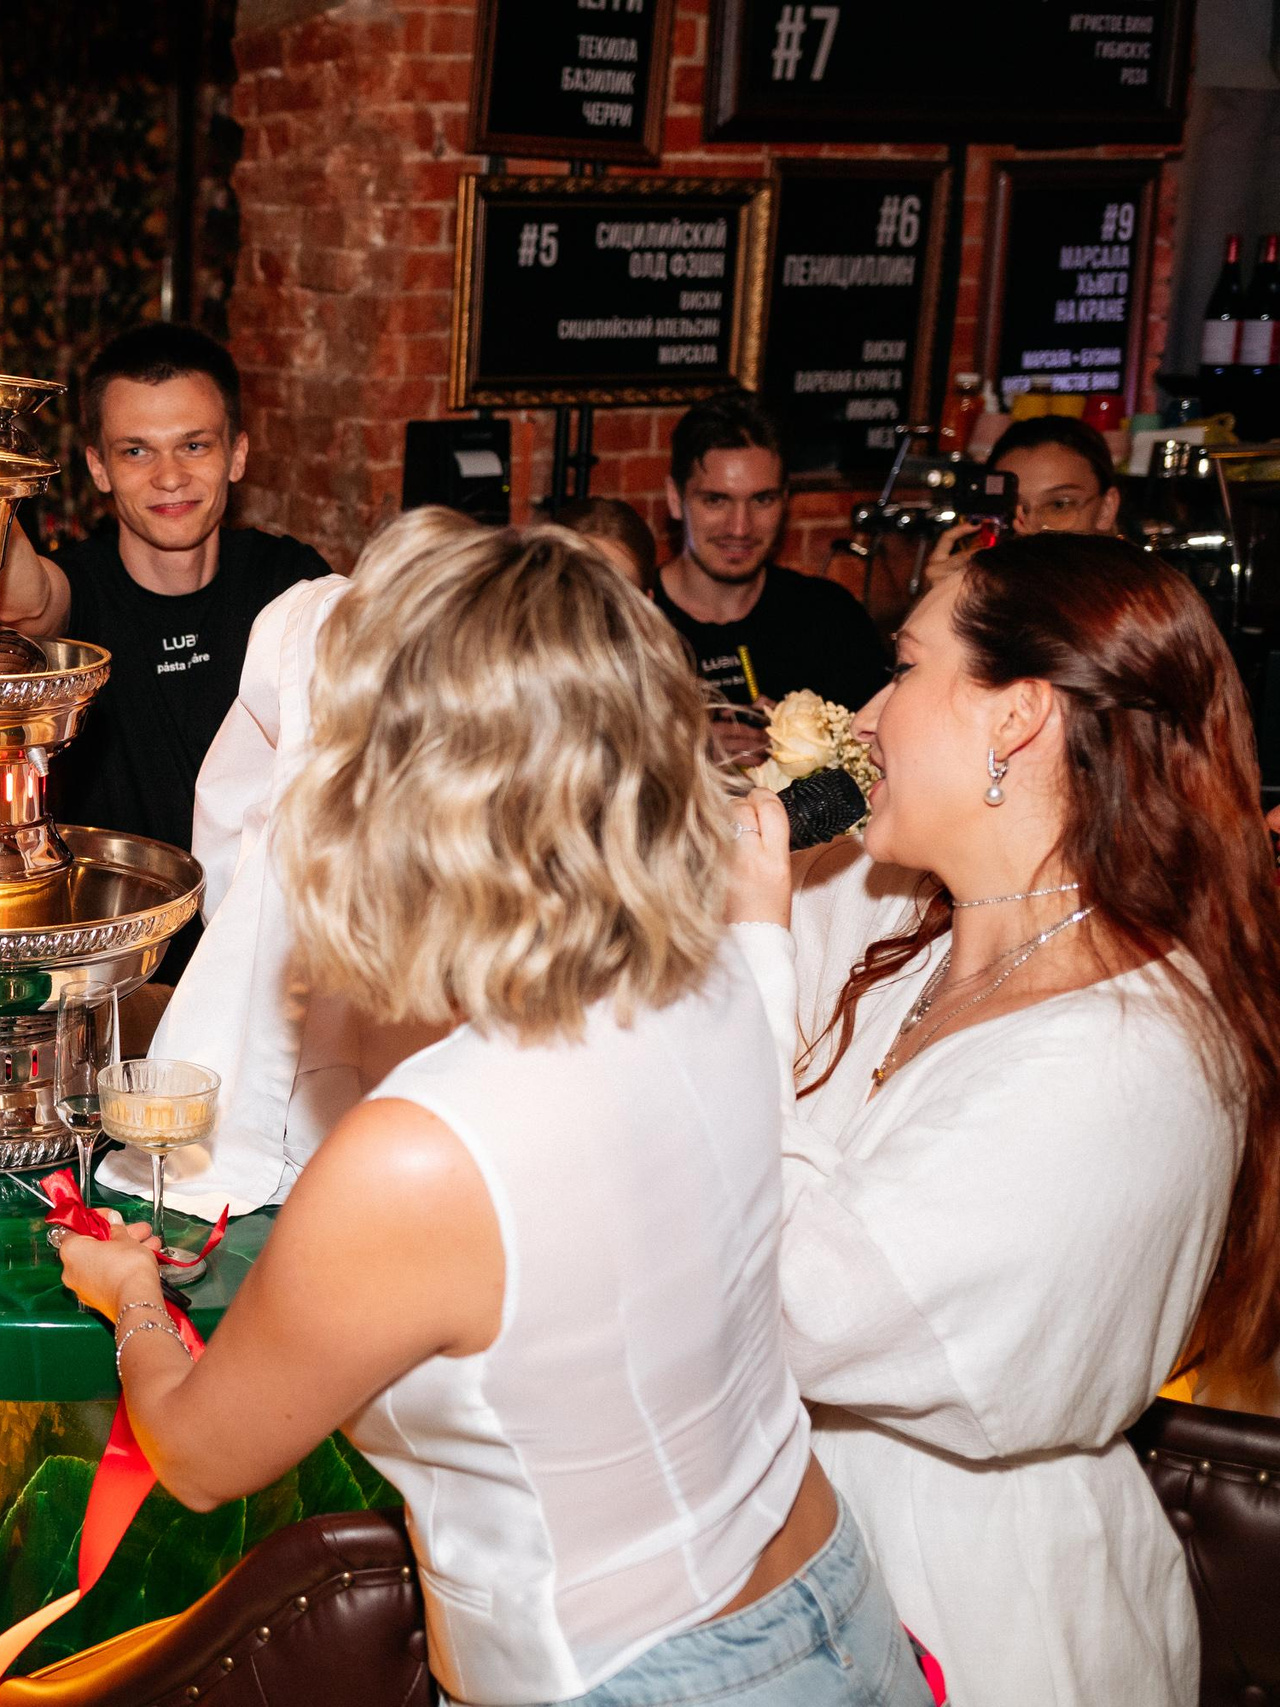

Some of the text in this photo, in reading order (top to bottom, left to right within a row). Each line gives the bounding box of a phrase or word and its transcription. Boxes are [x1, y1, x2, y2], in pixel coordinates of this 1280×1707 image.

[577, 33, 638, 63] ТЕКИЛА
[772, 5, 840, 81] #7
[560, 65, 636, 95] БАЗИЛИК
[582, 100, 634, 128] ЧЕРРИ
[595, 216, 727, 251] СИЦИЛИЙСКИЙ
[875, 194, 922, 248] #6
[1101, 202, 1136, 242] #9
[517, 221, 560, 268] #5
[628, 250, 726, 281] ОЛД ФЭШН
[782, 253, 917, 291] ПЕНИЦИЛЛИН
[162, 633, 199, 651] LUB
